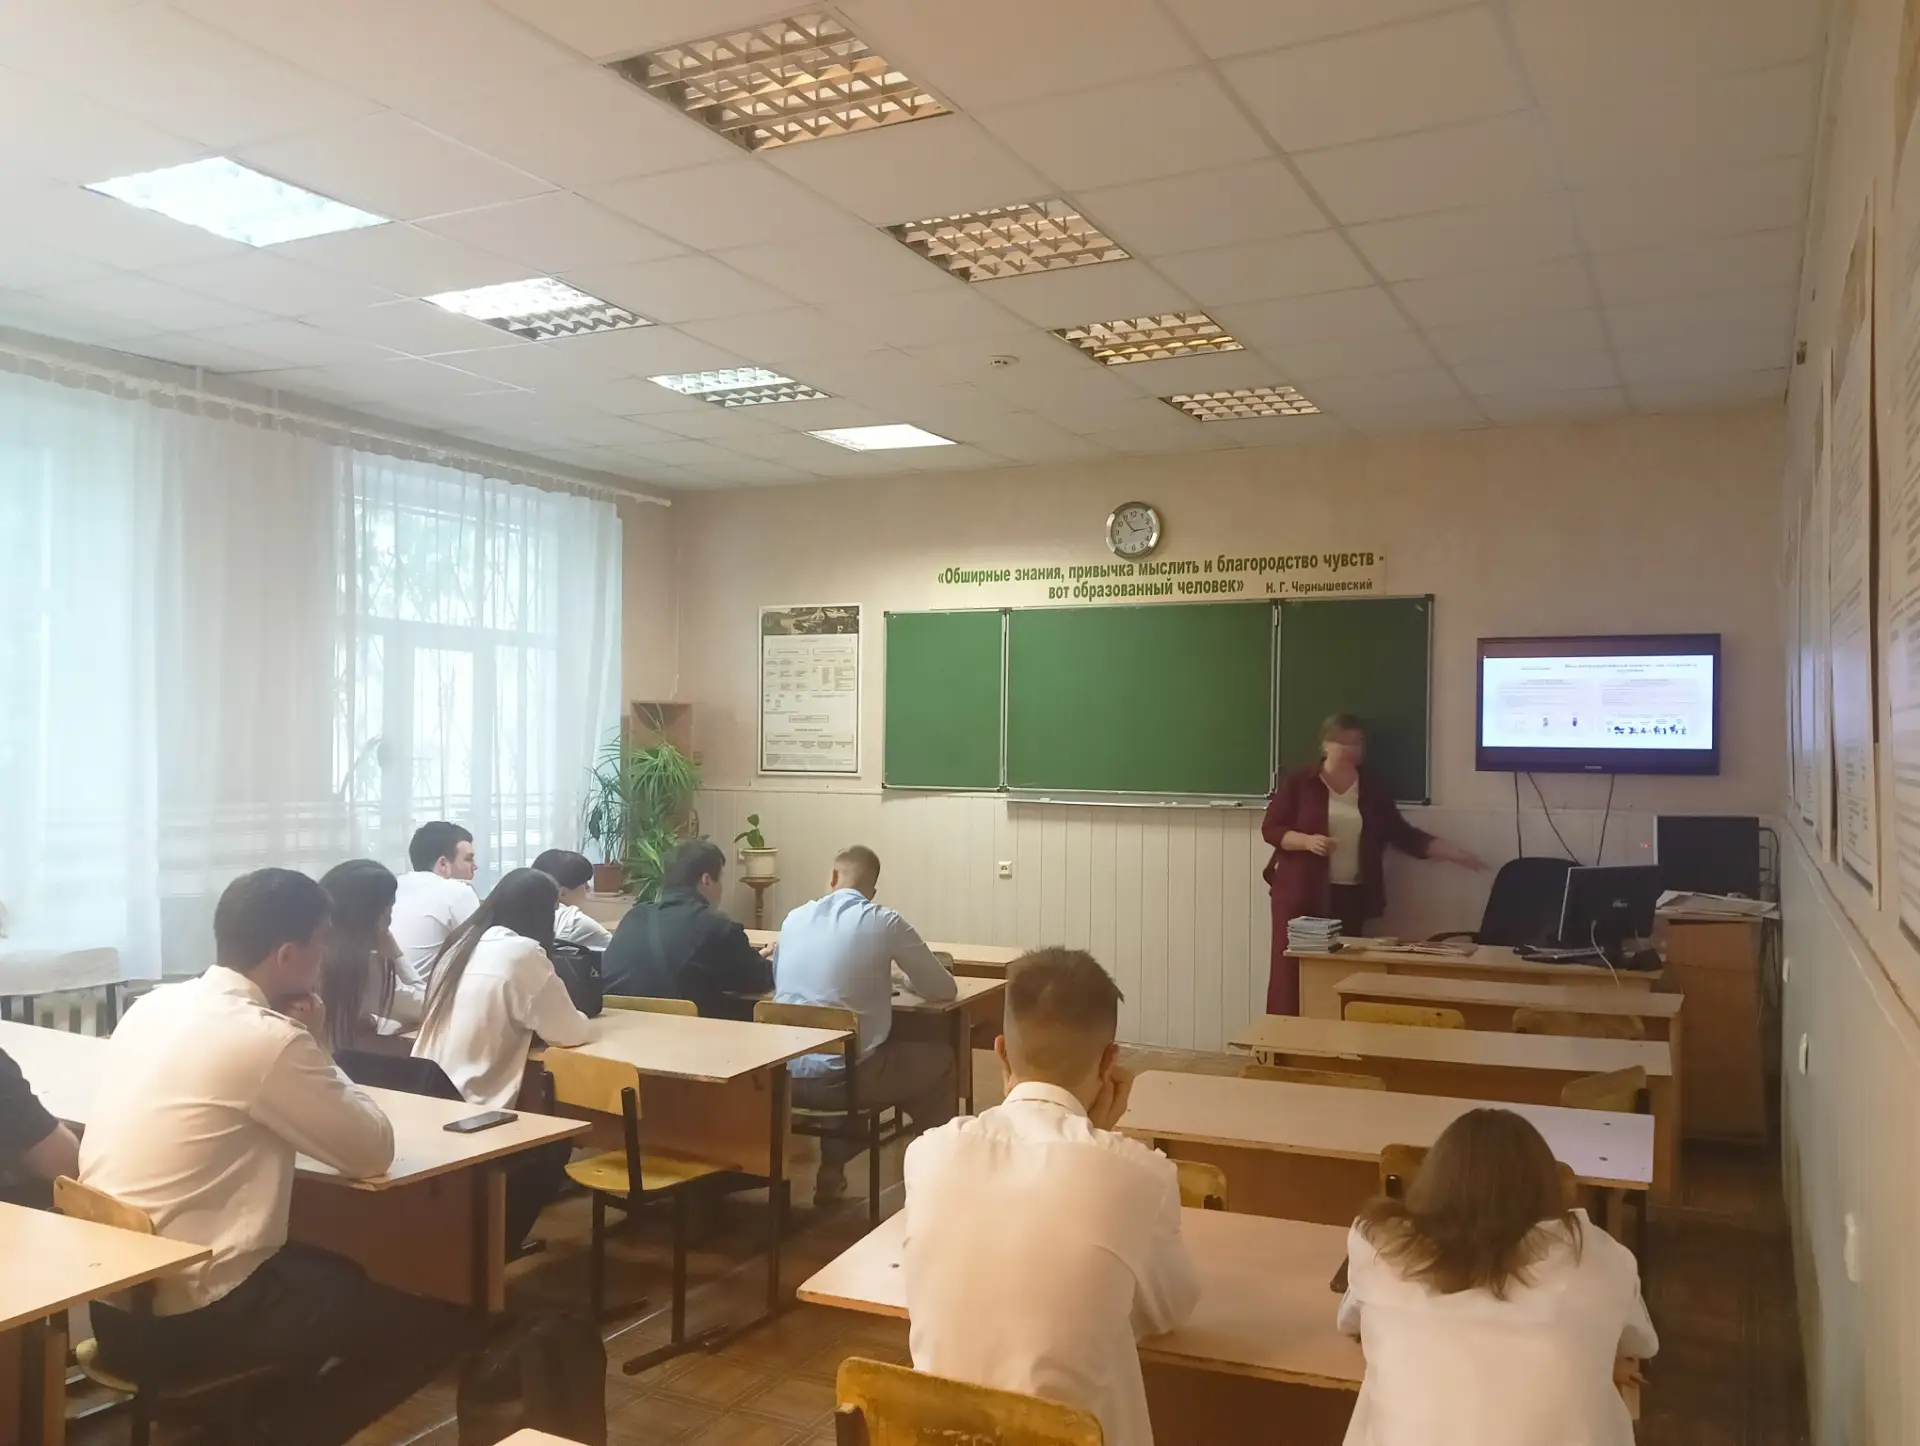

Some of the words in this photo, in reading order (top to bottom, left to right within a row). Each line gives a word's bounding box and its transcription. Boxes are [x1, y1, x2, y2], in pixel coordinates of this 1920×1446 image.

[938, 566, 1011, 586] «Обширные
[1015, 566, 1064, 582] знания,
[1069, 563, 1134, 582] привычка
[1139, 559, 1199, 576] мыслить
[1204, 560, 1213, 573] и
[1217, 554, 1318, 575] благородство
[1323, 552, 1374, 572] чувств
[1049, 584, 1070, 599] вот
[1073, 577, 1173, 601] образованный
[1177, 578, 1245, 595] человек»
[1266, 581, 1276, 594] Н.
[1279, 581, 1289, 593] Г.
[1292, 578, 1373, 595] Чернышевский
